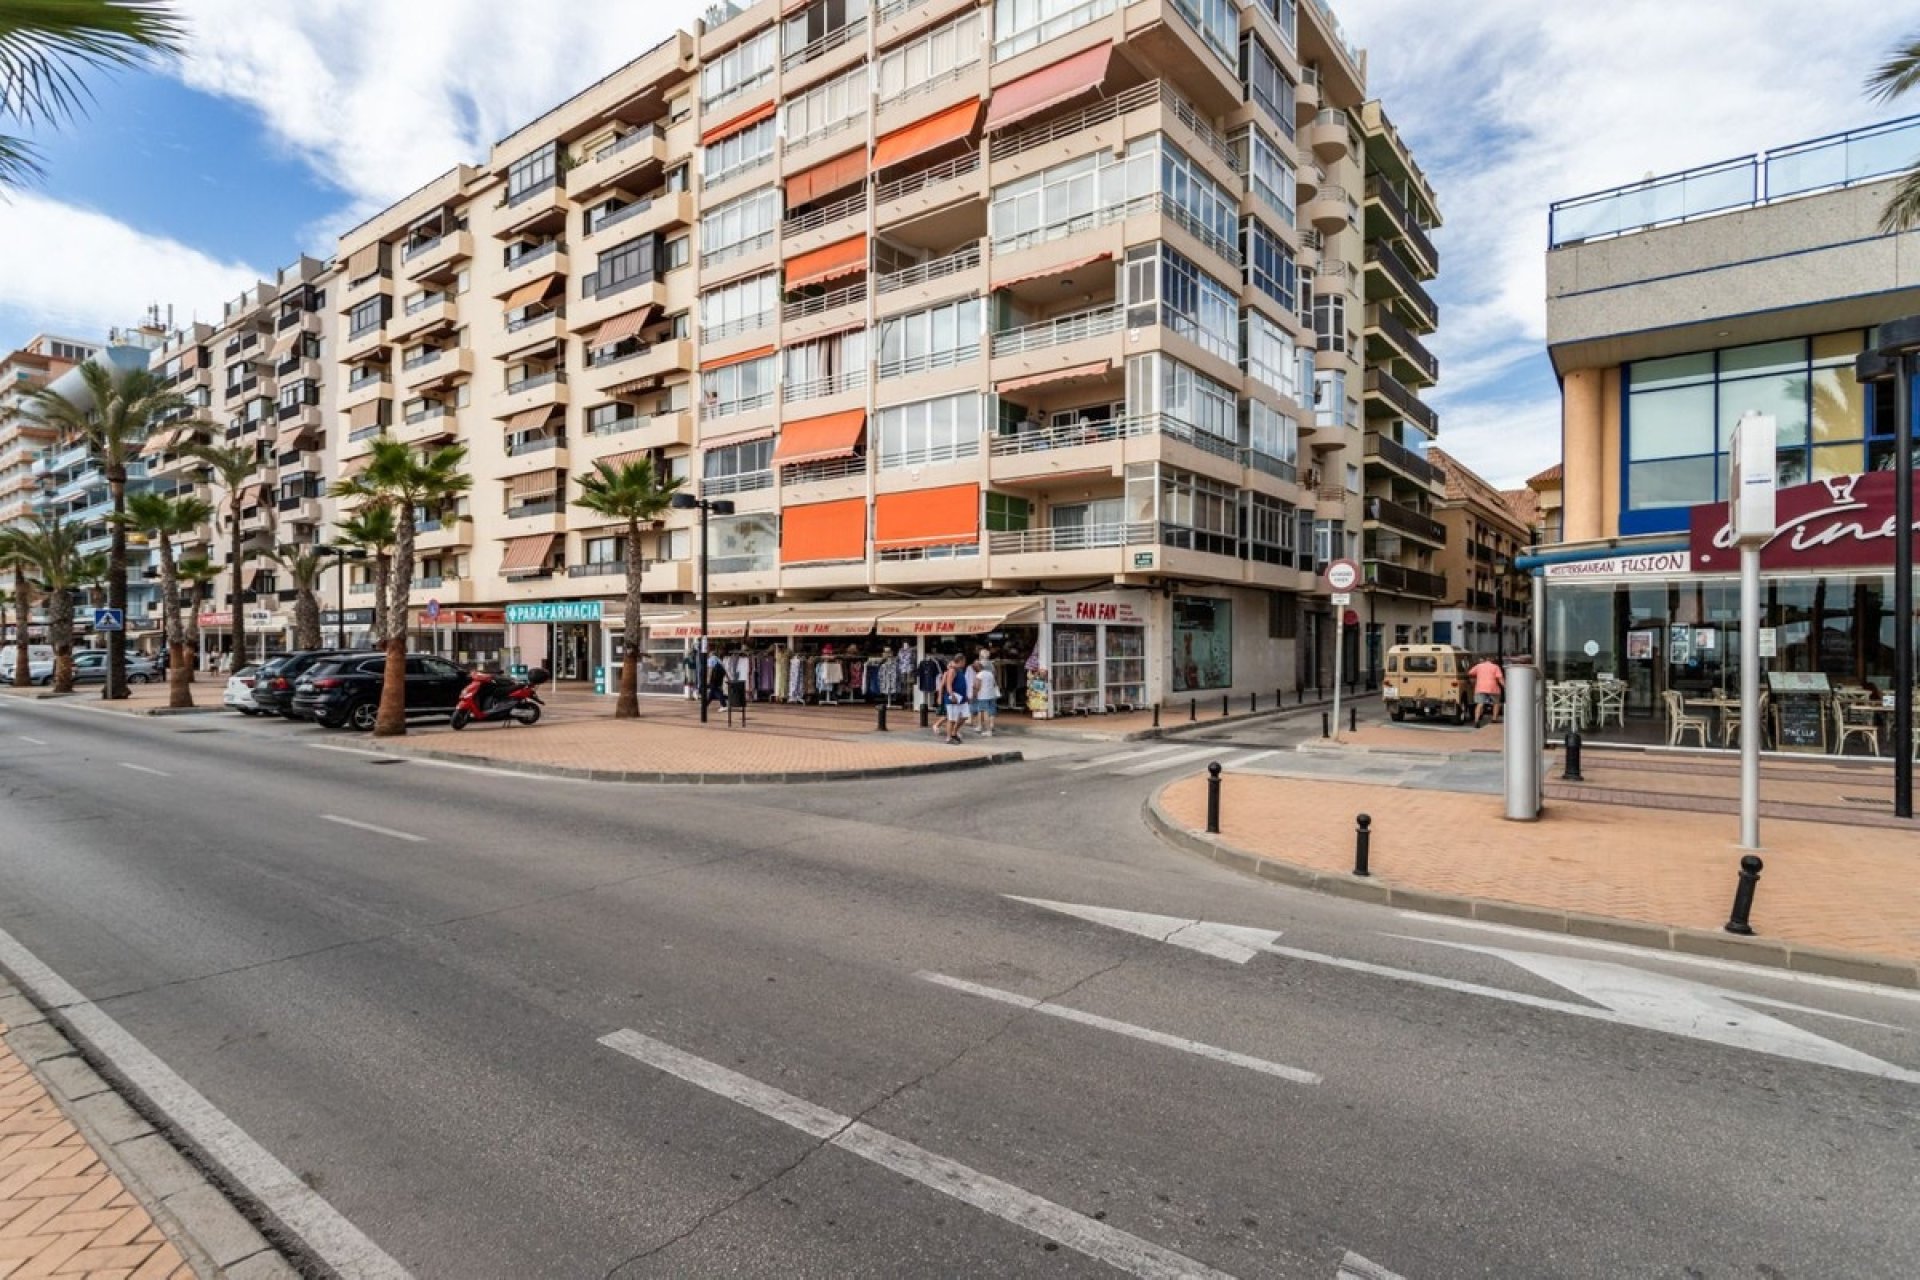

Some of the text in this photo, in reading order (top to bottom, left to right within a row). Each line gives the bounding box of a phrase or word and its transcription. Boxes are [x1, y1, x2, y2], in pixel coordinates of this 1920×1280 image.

[1550, 555, 1683, 575] MEDITERRANEAN FUSION
[517, 604, 599, 620] PARAFARMACIA
[1076, 602, 1117, 620] FAN FAN
[793, 624, 830, 633] FAN FAN
[914, 622, 955, 632] FAN FAN
